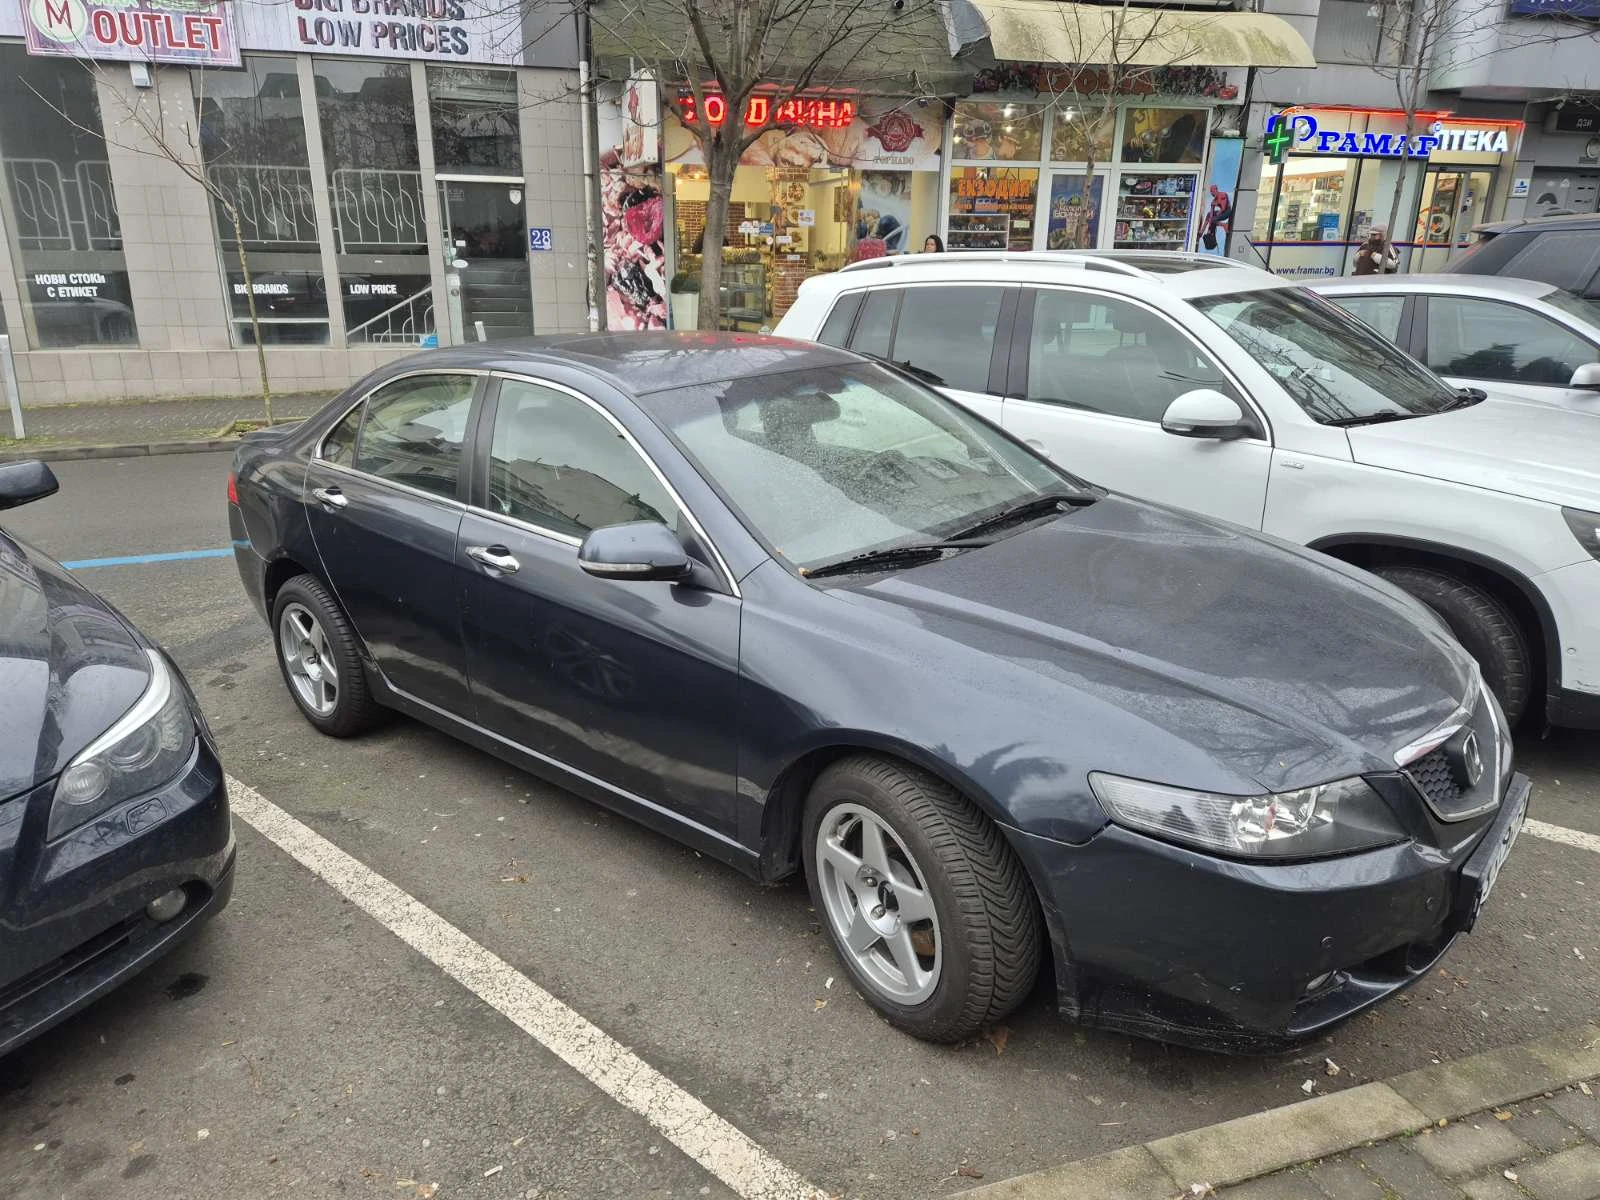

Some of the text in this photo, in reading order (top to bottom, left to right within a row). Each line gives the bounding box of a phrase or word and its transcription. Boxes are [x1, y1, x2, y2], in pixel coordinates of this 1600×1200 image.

[92, 10, 222, 49] OUTLET
[297, 16, 470, 55] LOW PRICES
[1431, 129, 1508, 151] ПТЕКА
[532, 230, 550, 246] 28
[1276, 265, 1334, 276] www.framar.bg
[35, 273, 67, 285] НОВИ
[46, 286, 98, 298] С ЕТИКЕТ
[252, 284, 288, 294] BRANDS
[350, 284, 397, 294] LOW PRICE
